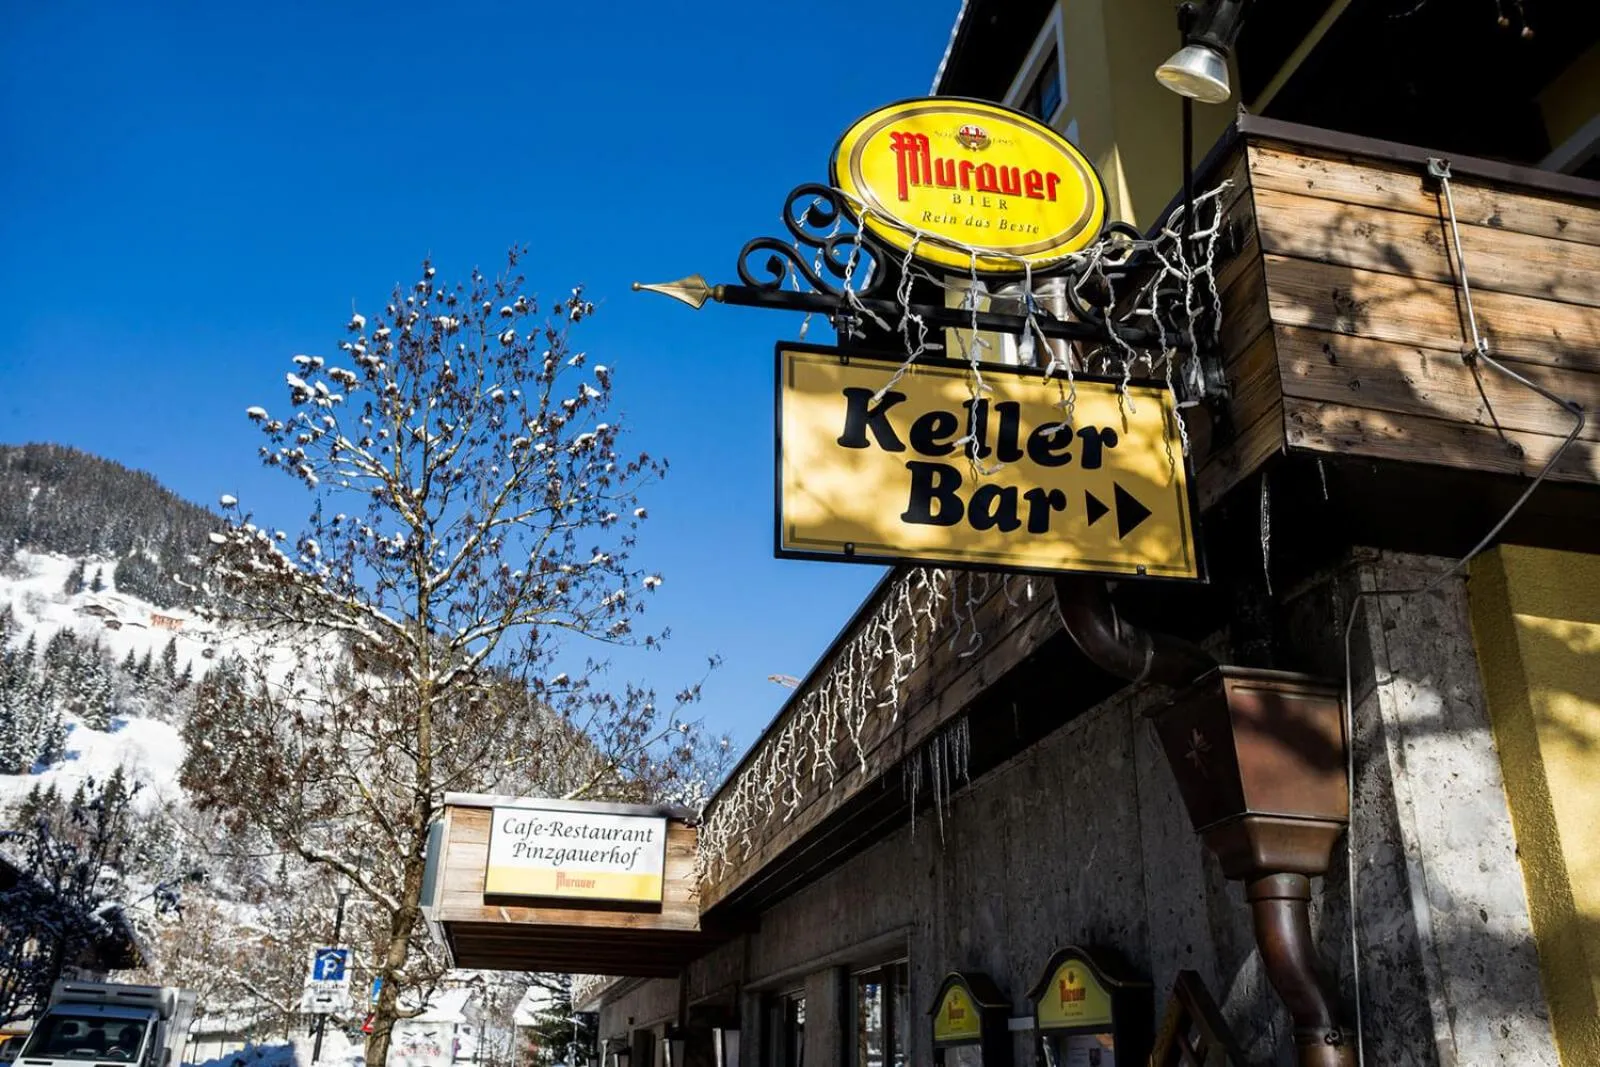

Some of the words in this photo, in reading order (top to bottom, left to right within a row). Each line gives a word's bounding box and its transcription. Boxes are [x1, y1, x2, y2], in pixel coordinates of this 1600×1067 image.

[889, 131, 1061, 202] Murauer
[952, 193, 1009, 210] BIER
[922, 210, 958, 226] Rein
[965, 215, 991, 228] das
[998, 219, 1040, 235] Beste
[837, 387, 1118, 470] Keller
[900, 460, 1067, 534] Bar
[503, 817, 654, 844] Cafe-Restaurant
[512, 842, 641, 870] Pinzgauerhof
[322, 959, 337, 979] P
